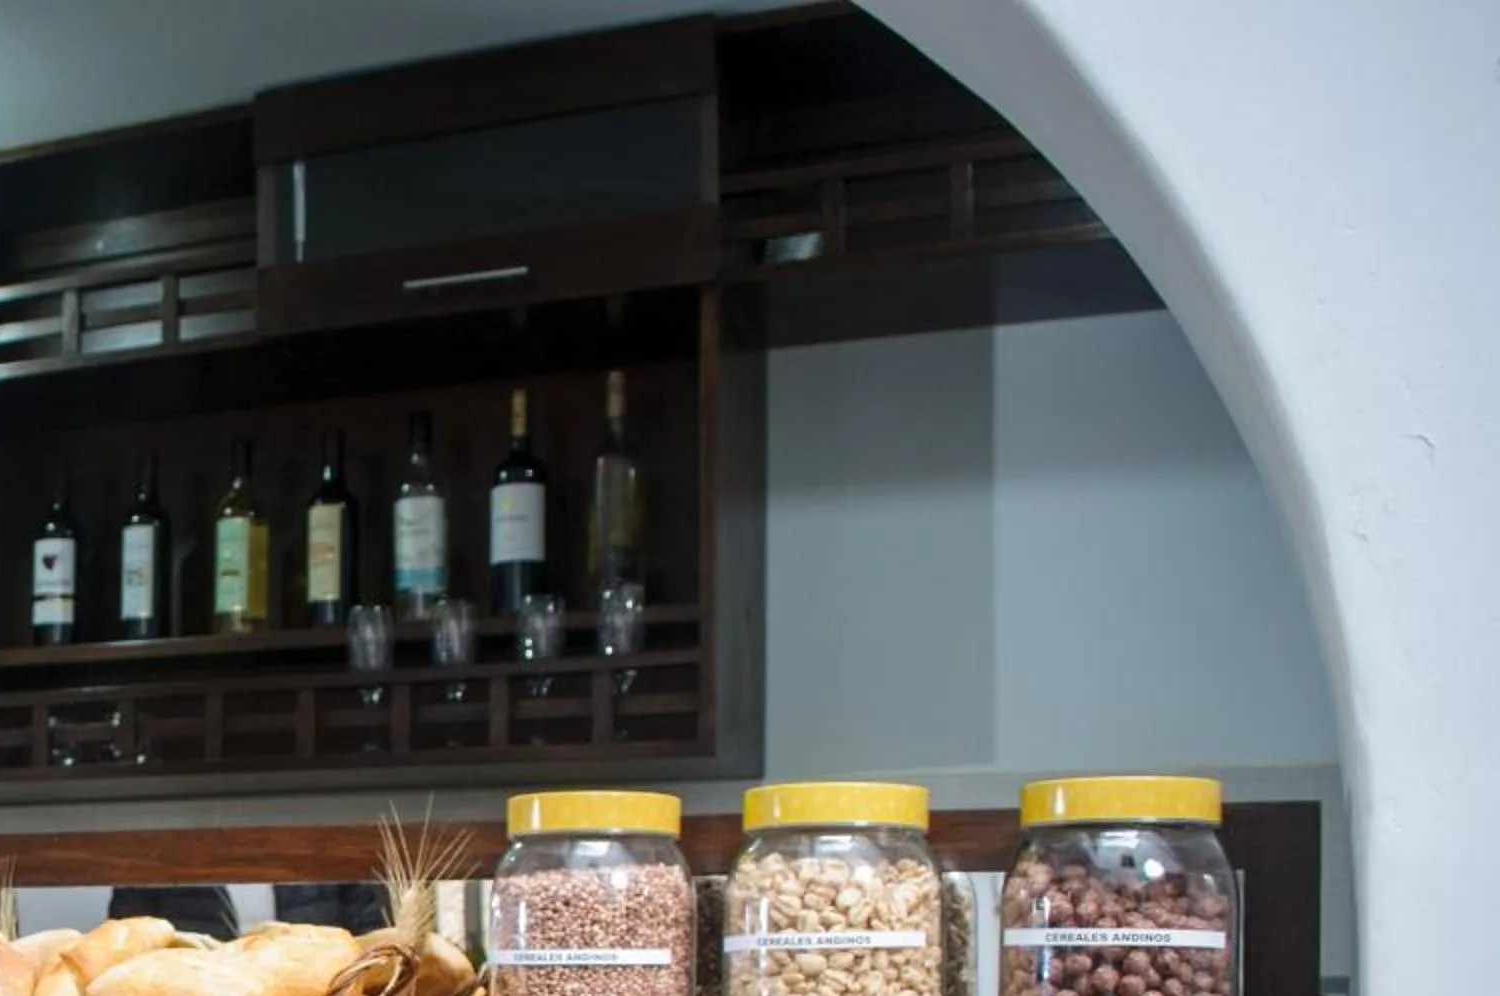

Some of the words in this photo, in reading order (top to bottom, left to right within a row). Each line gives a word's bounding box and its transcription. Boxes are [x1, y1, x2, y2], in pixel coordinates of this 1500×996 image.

[756, 936, 812, 947] CEREALES
[815, 935, 871, 946] ANDINOS
[1045, 932, 1109, 943] CEREALES
[1112, 932, 1171, 943] ANDINOS
[513, 952, 562, 962] CEREALES
[566, 952, 619, 961] ANDINOS
